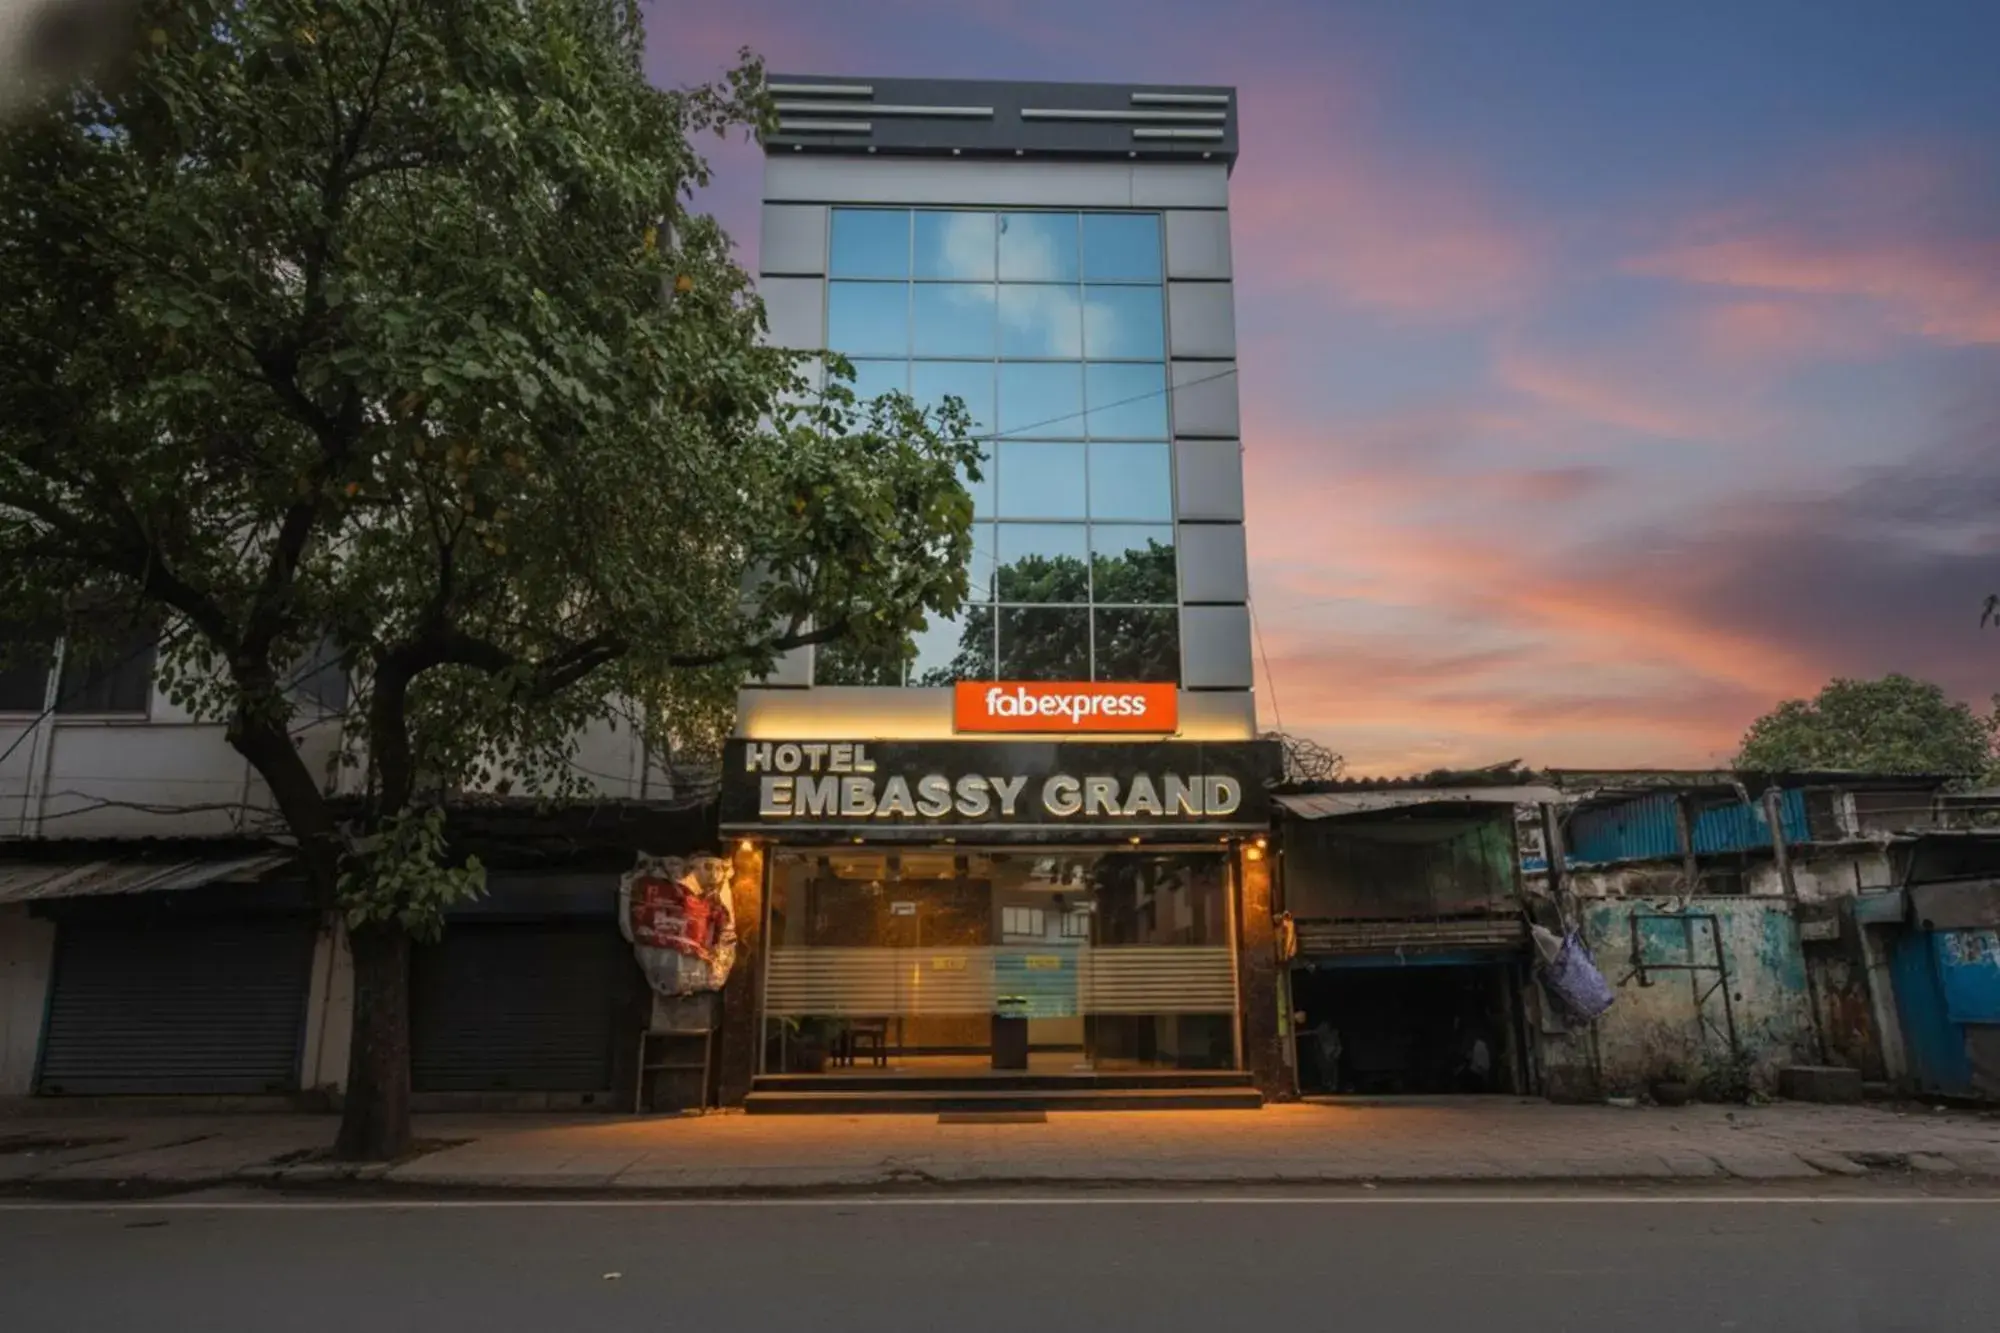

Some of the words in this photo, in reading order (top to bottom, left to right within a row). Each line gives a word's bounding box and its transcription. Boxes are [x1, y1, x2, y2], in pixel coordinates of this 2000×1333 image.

[985, 687, 1147, 724] fabexpress
[746, 743, 876, 772] HOTEL
[759, 774, 1028, 817] EMBASSY
[1042, 774, 1242, 817] GRAND
